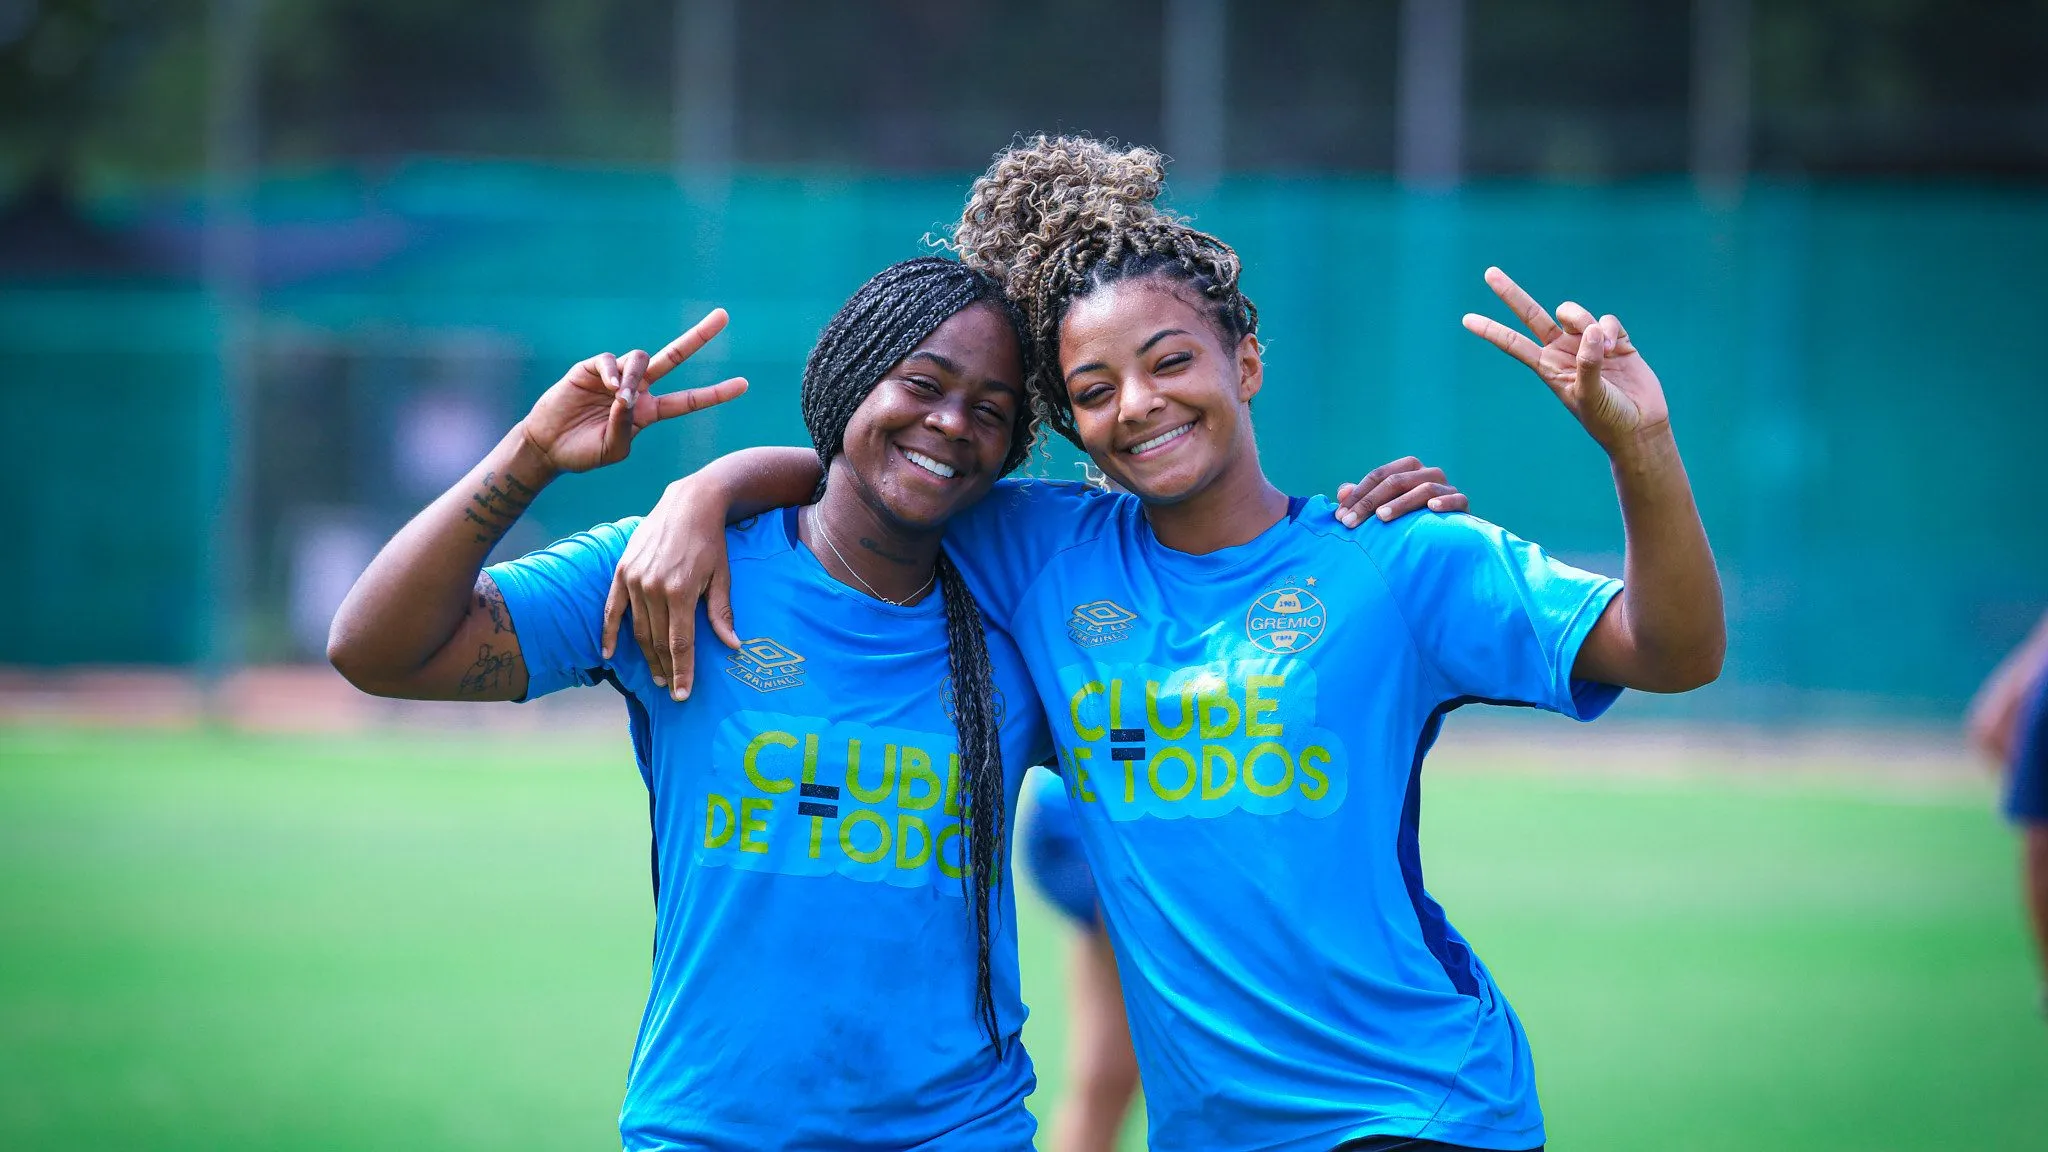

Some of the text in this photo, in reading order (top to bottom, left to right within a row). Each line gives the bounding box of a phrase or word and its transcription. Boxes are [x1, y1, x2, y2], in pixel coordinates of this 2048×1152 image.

[1070, 675, 1285, 742] CLUBE
[1111, 742, 1332, 802] TODOS
[703, 794, 1000, 888] DE TODO
